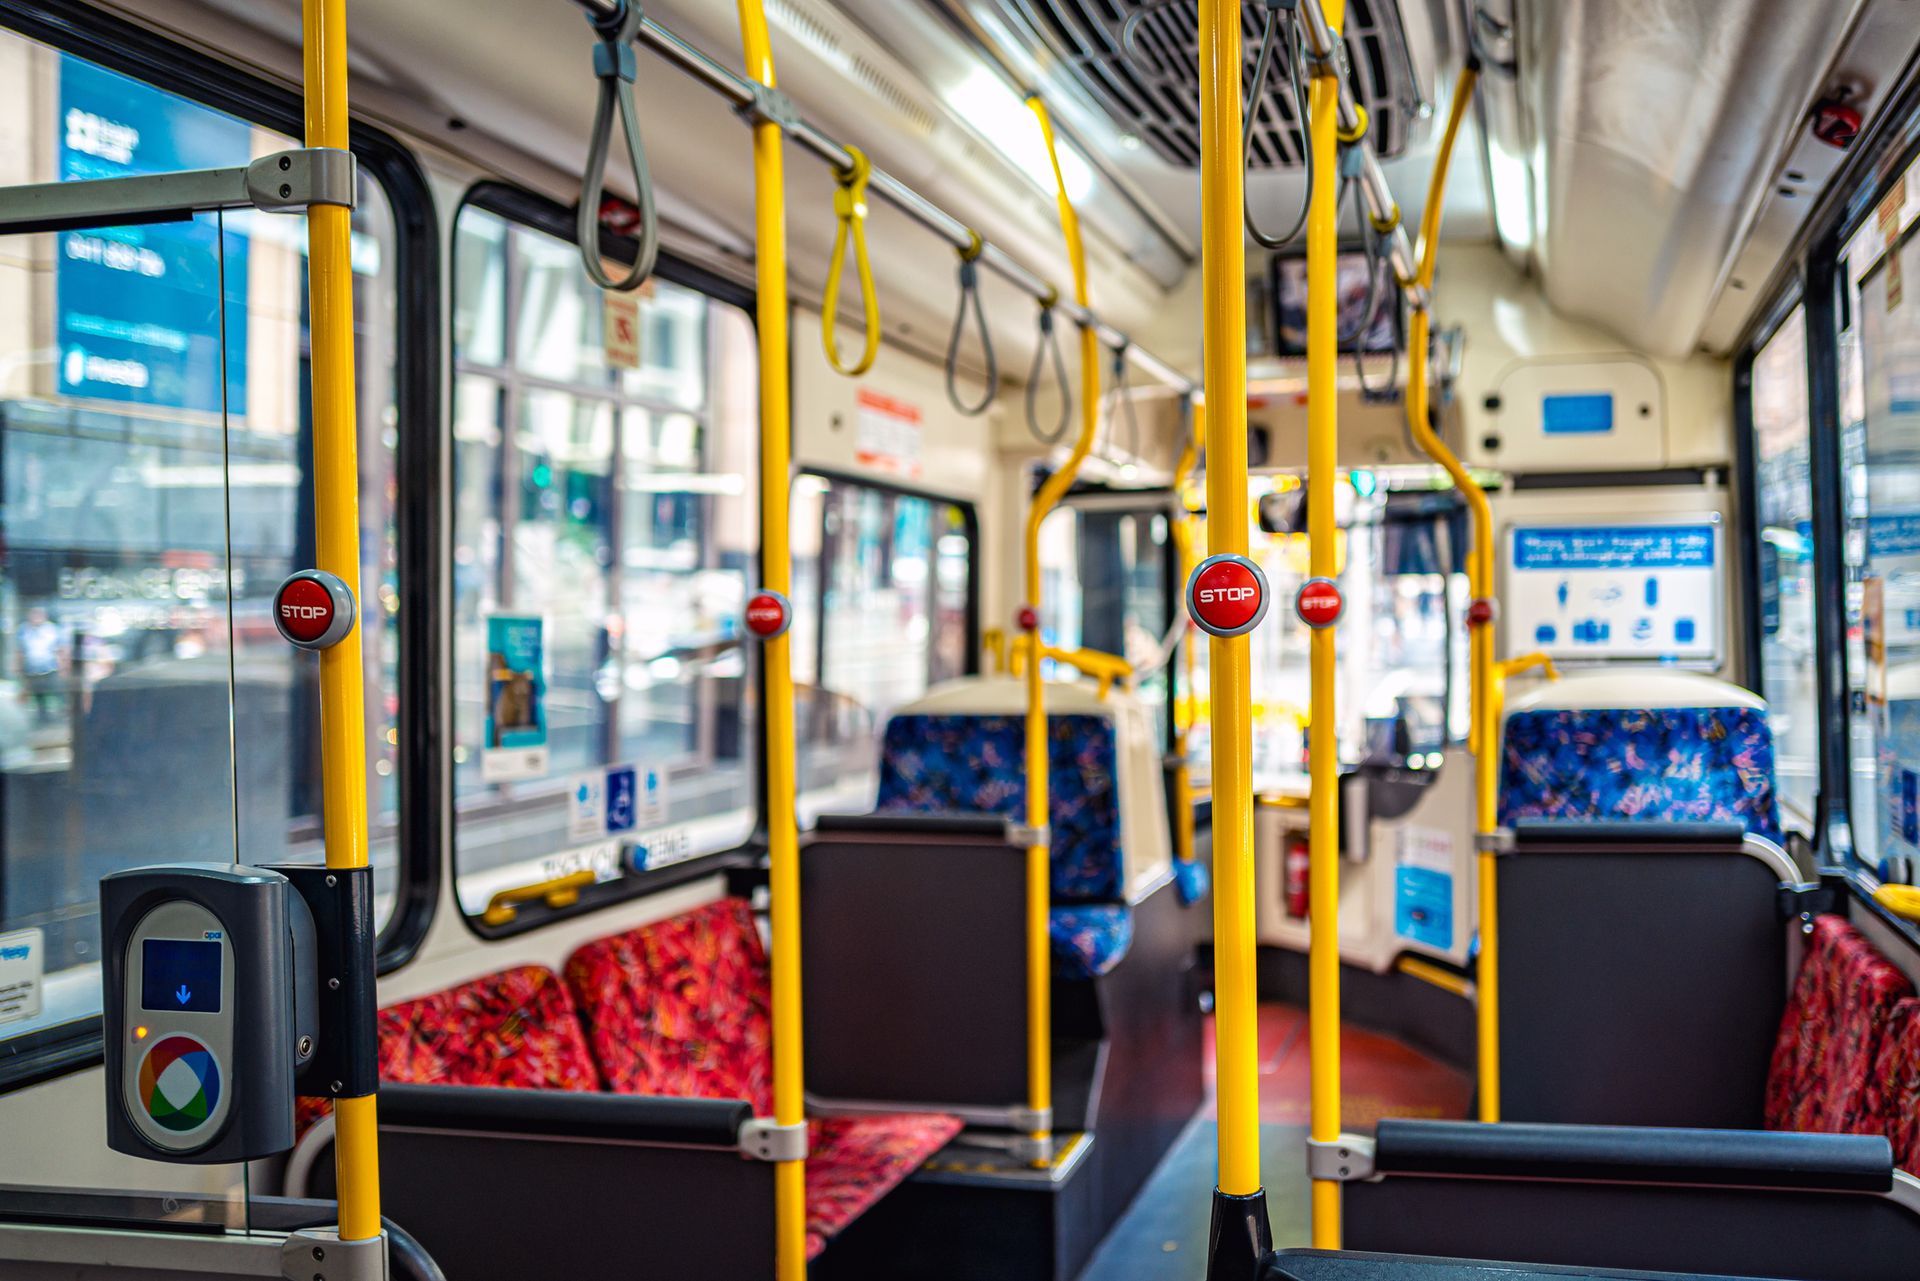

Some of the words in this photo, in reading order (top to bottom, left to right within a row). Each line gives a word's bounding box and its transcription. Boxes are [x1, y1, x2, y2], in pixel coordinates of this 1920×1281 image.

[1200, 587, 1255, 603] STOP
[1301, 596, 1339, 610] STOP
[281, 605, 328, 619] STOP
